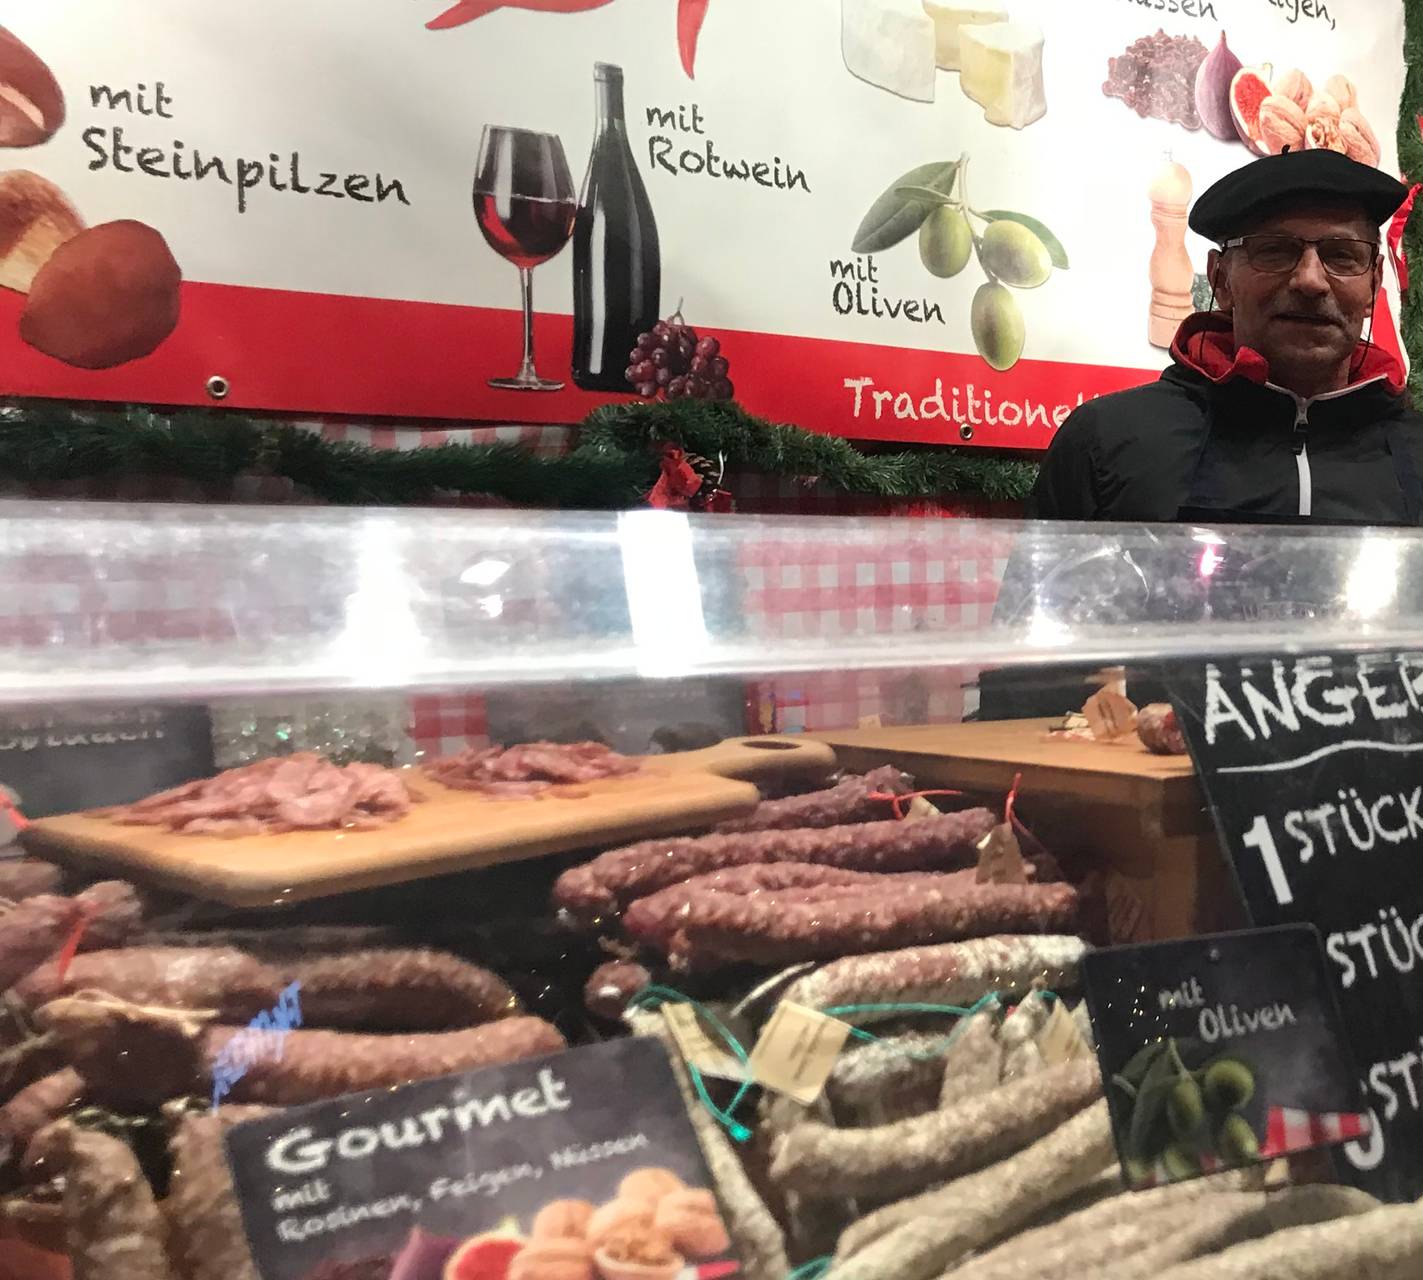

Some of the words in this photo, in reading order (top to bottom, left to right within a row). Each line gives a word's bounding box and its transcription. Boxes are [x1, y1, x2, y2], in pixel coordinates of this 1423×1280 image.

[1121, 0, 1218, 22] ssen
[91, 82, 173, 120] mit
[646, 104, 705, 135] mit
[82, 127, 412, 214] Steinpilzen
[648, 136, 812, 193] Rotwein
[829, 255, 879, 284] mit
[832, 281, 946, 325] Oliven
[843, 377, 1100, 429] Traditione
[1243, 814, 1293, 904] 1
[1159, 976, 1205, 1010] mit
[1199, 1000, 1298, 1043] Oliven
[266, 1067, 572, 1174] Gourmet
[270, 1178, 331, 1213] mit
